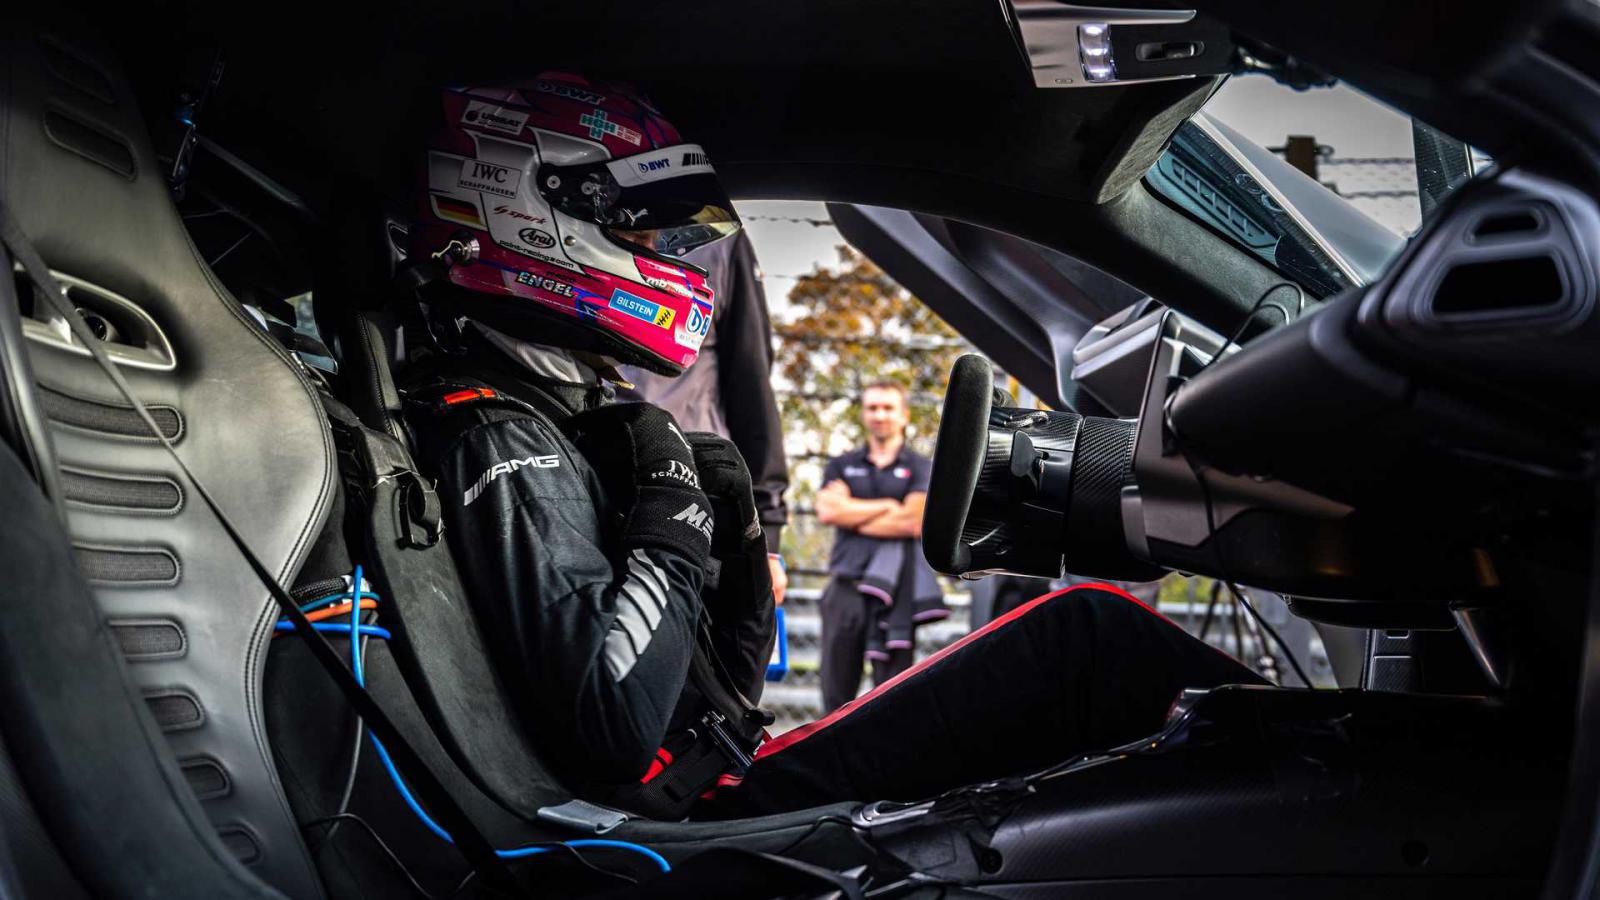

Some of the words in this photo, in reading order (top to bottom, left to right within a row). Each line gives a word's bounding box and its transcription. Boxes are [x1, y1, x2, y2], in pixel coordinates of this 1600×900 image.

[472, 162, 508, 183] IWC
[648, 158, 671, 171] BWT
[460, 180, 515, 196] SCHAFFHAUSEN
[525, 230, 553, 246] Arai
[515, 271, 574, 299] ENGEL
[616, 296, 654, 317] BILSTEIN
[490, 454, 560, 481] AMG
